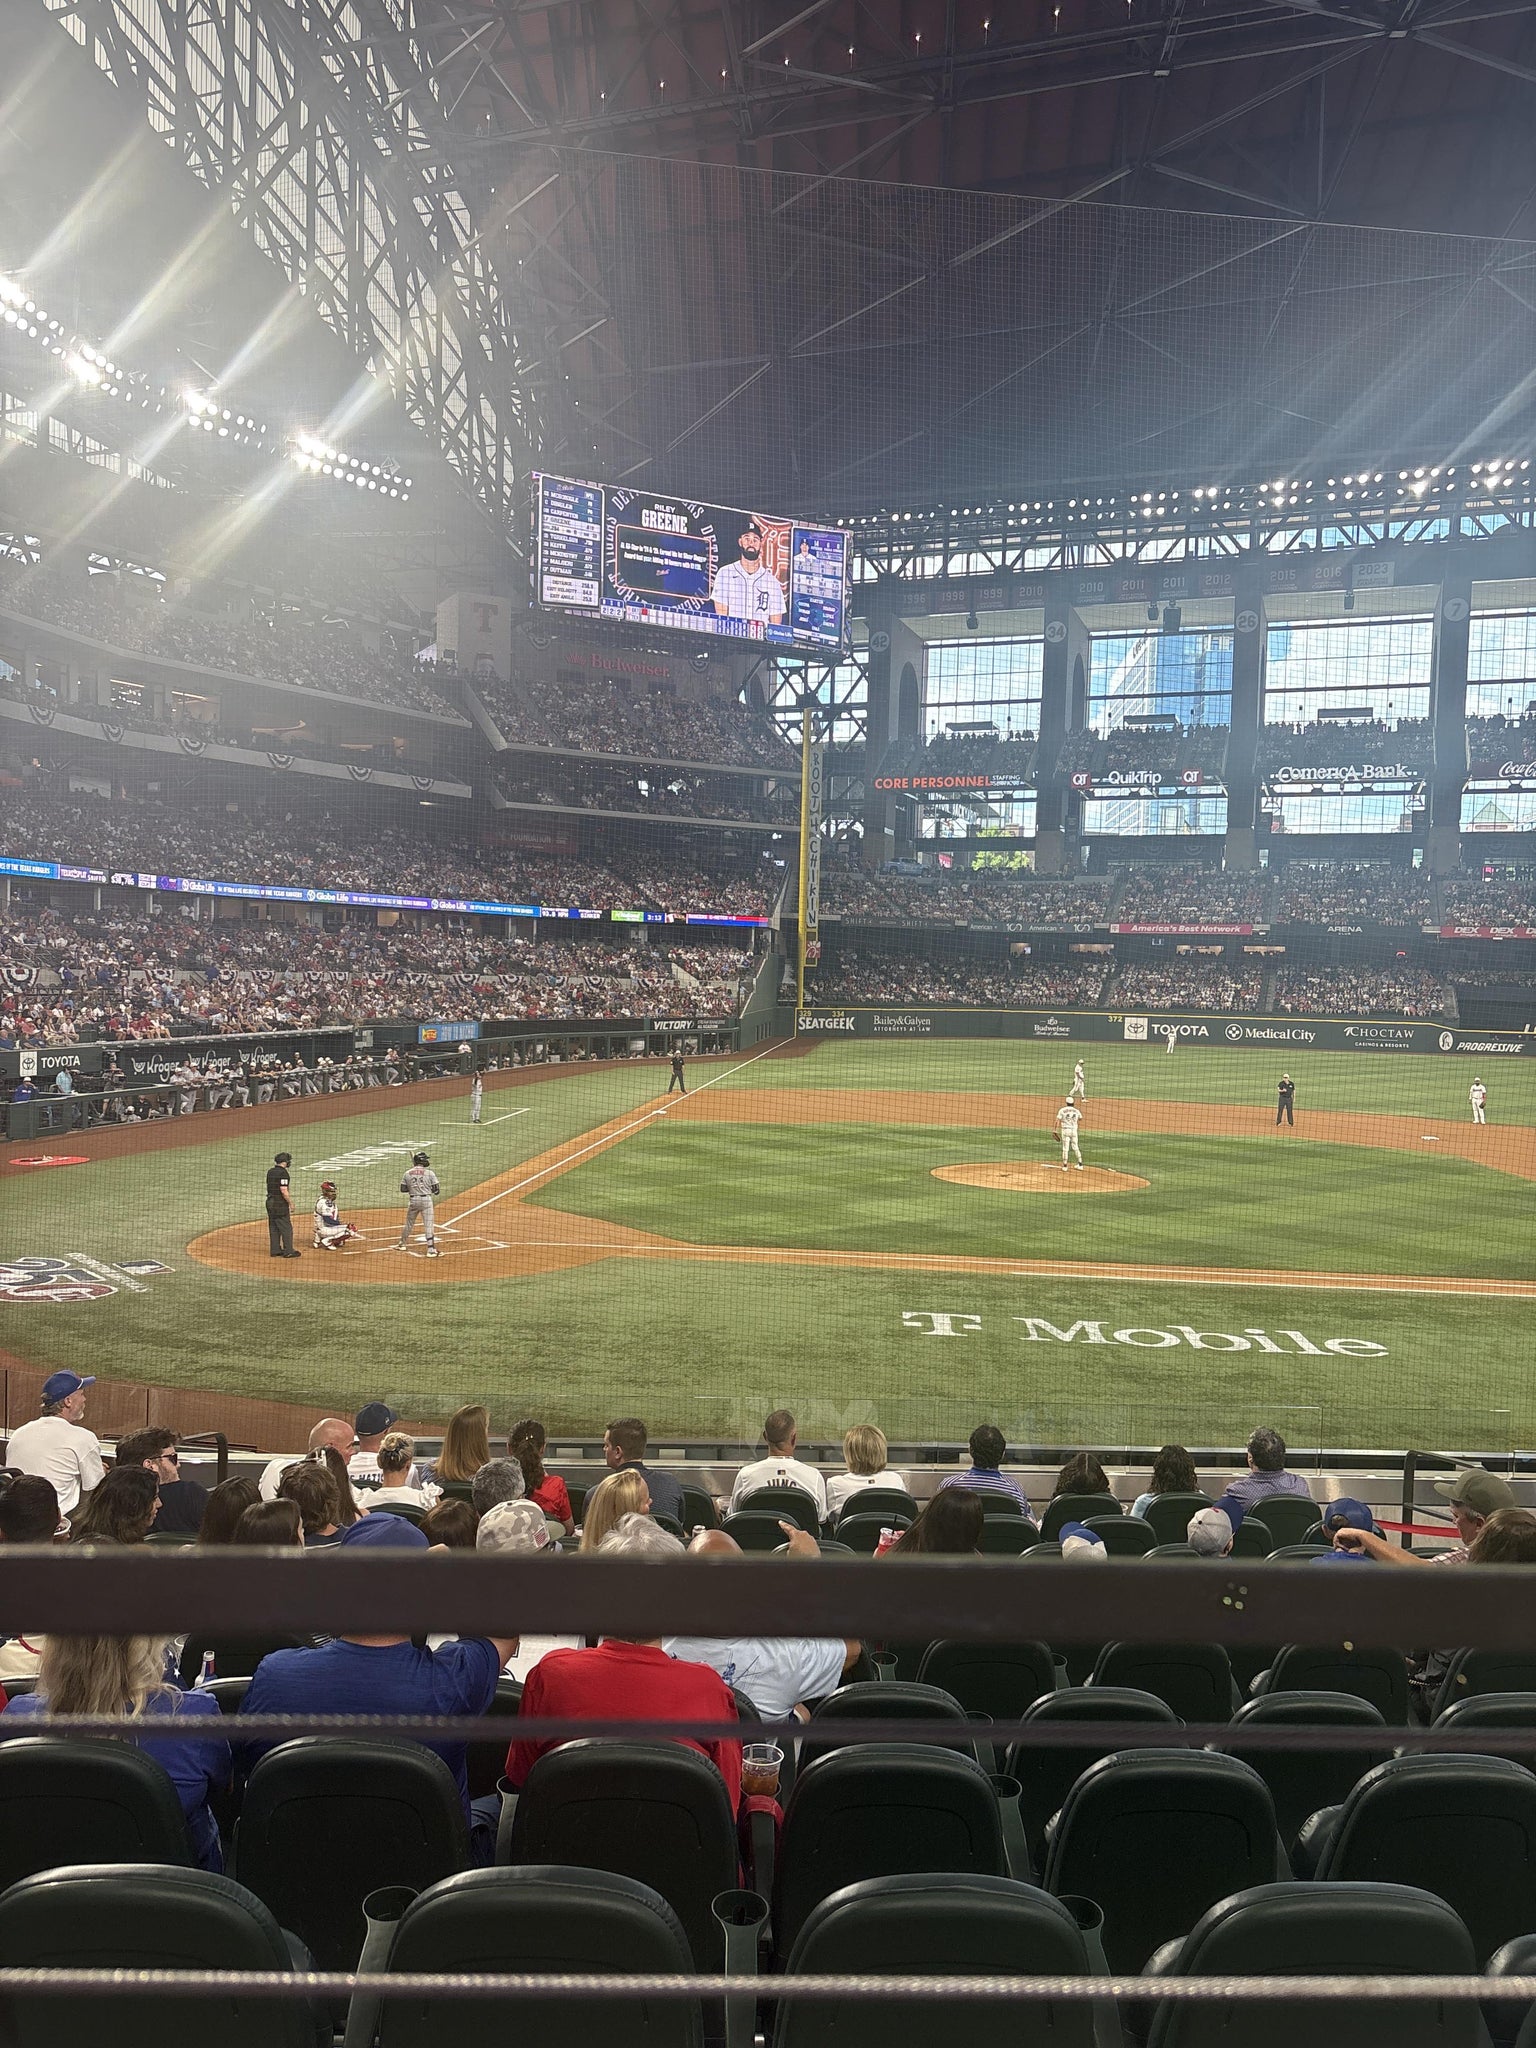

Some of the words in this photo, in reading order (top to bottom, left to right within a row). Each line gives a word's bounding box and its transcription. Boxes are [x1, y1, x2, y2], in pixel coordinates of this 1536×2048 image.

[654, 503, 676, 514] RILEY
[641, 508, 688, 534] GREENE
[1270, 570, 1296, 581] 2015
[1315, 566, 1342, 579] 2016
[1358, 563, 1388, 576] 2023
[1122, 579, 1145, 591] 2011
[1162, 577, 1185, 588] 2011
[1205, 574, 1231, 585] 2012
[979, 588, 1003, 599] 1999
[1019, 586, 1043, 597] 2010
[1079, 582, 1104, 593] 2010
[942, 591, 965, 601] 1998
[1451, 602, 1461, 617] 7
[1238, 615, 1257, 628] 26
[1047, 626, 1064, 639] 34
[872, 635, 888, 648] 42
[1183, 770, 1200, 782] QT
[1361, 763, 1410, 779] Bank
[875, 777, 909, 789] CORE
[912, 775, 991, 789] PERSONNEL
[1072, 774, 1088, 785] QT
[1108, 770, 1162, 786] QuikTrip
[189, 881, 204, 891] Globe
[205, 883, 215, 892] Life
[316, 891, 335, 901] Globe
[337, 892, 349, 902] Life
[439, 901, 455, 910] Globe
[456, 902, 467, 911] Life
[845, 917, 867, 925] SHIFT
[970, 923, 992, 931] American
[1029, 924, 1057, 932] American
[1131, 924, 1177, 933] America's
[1200, 925, 1241, 933] Network
[1327, 925, 1363, 933] ARENA
[1454, 926, 1480, 934] DEX
[653, 1020, 693, 1030] VICTORY
[798, 1016, 855, 1030] SEATGEEK
[1108, 1015, 1123, 1023] 372
[1034, 1024, 1070, 1032] Budweiser
[1151, 1023, 1210, 1037] TOYOTA
[1349, 1026, 1415, 1039] CHOCTAW
[1245, 1027, 1291, 1040] Medical
[1292, 1029, 1316, 1043] City
[1456, 1041, 1526, 1053] PROGRESSIVE
[201, 1050, 231, 1070] Kroger
[251, 1046, 278, 1064] Kroger
[41, 1055, 81, 1068] TOYOTA
[147, 1054, 180, 1083] Kroger
[1013, 1317, 1389, 1357] Mobile
